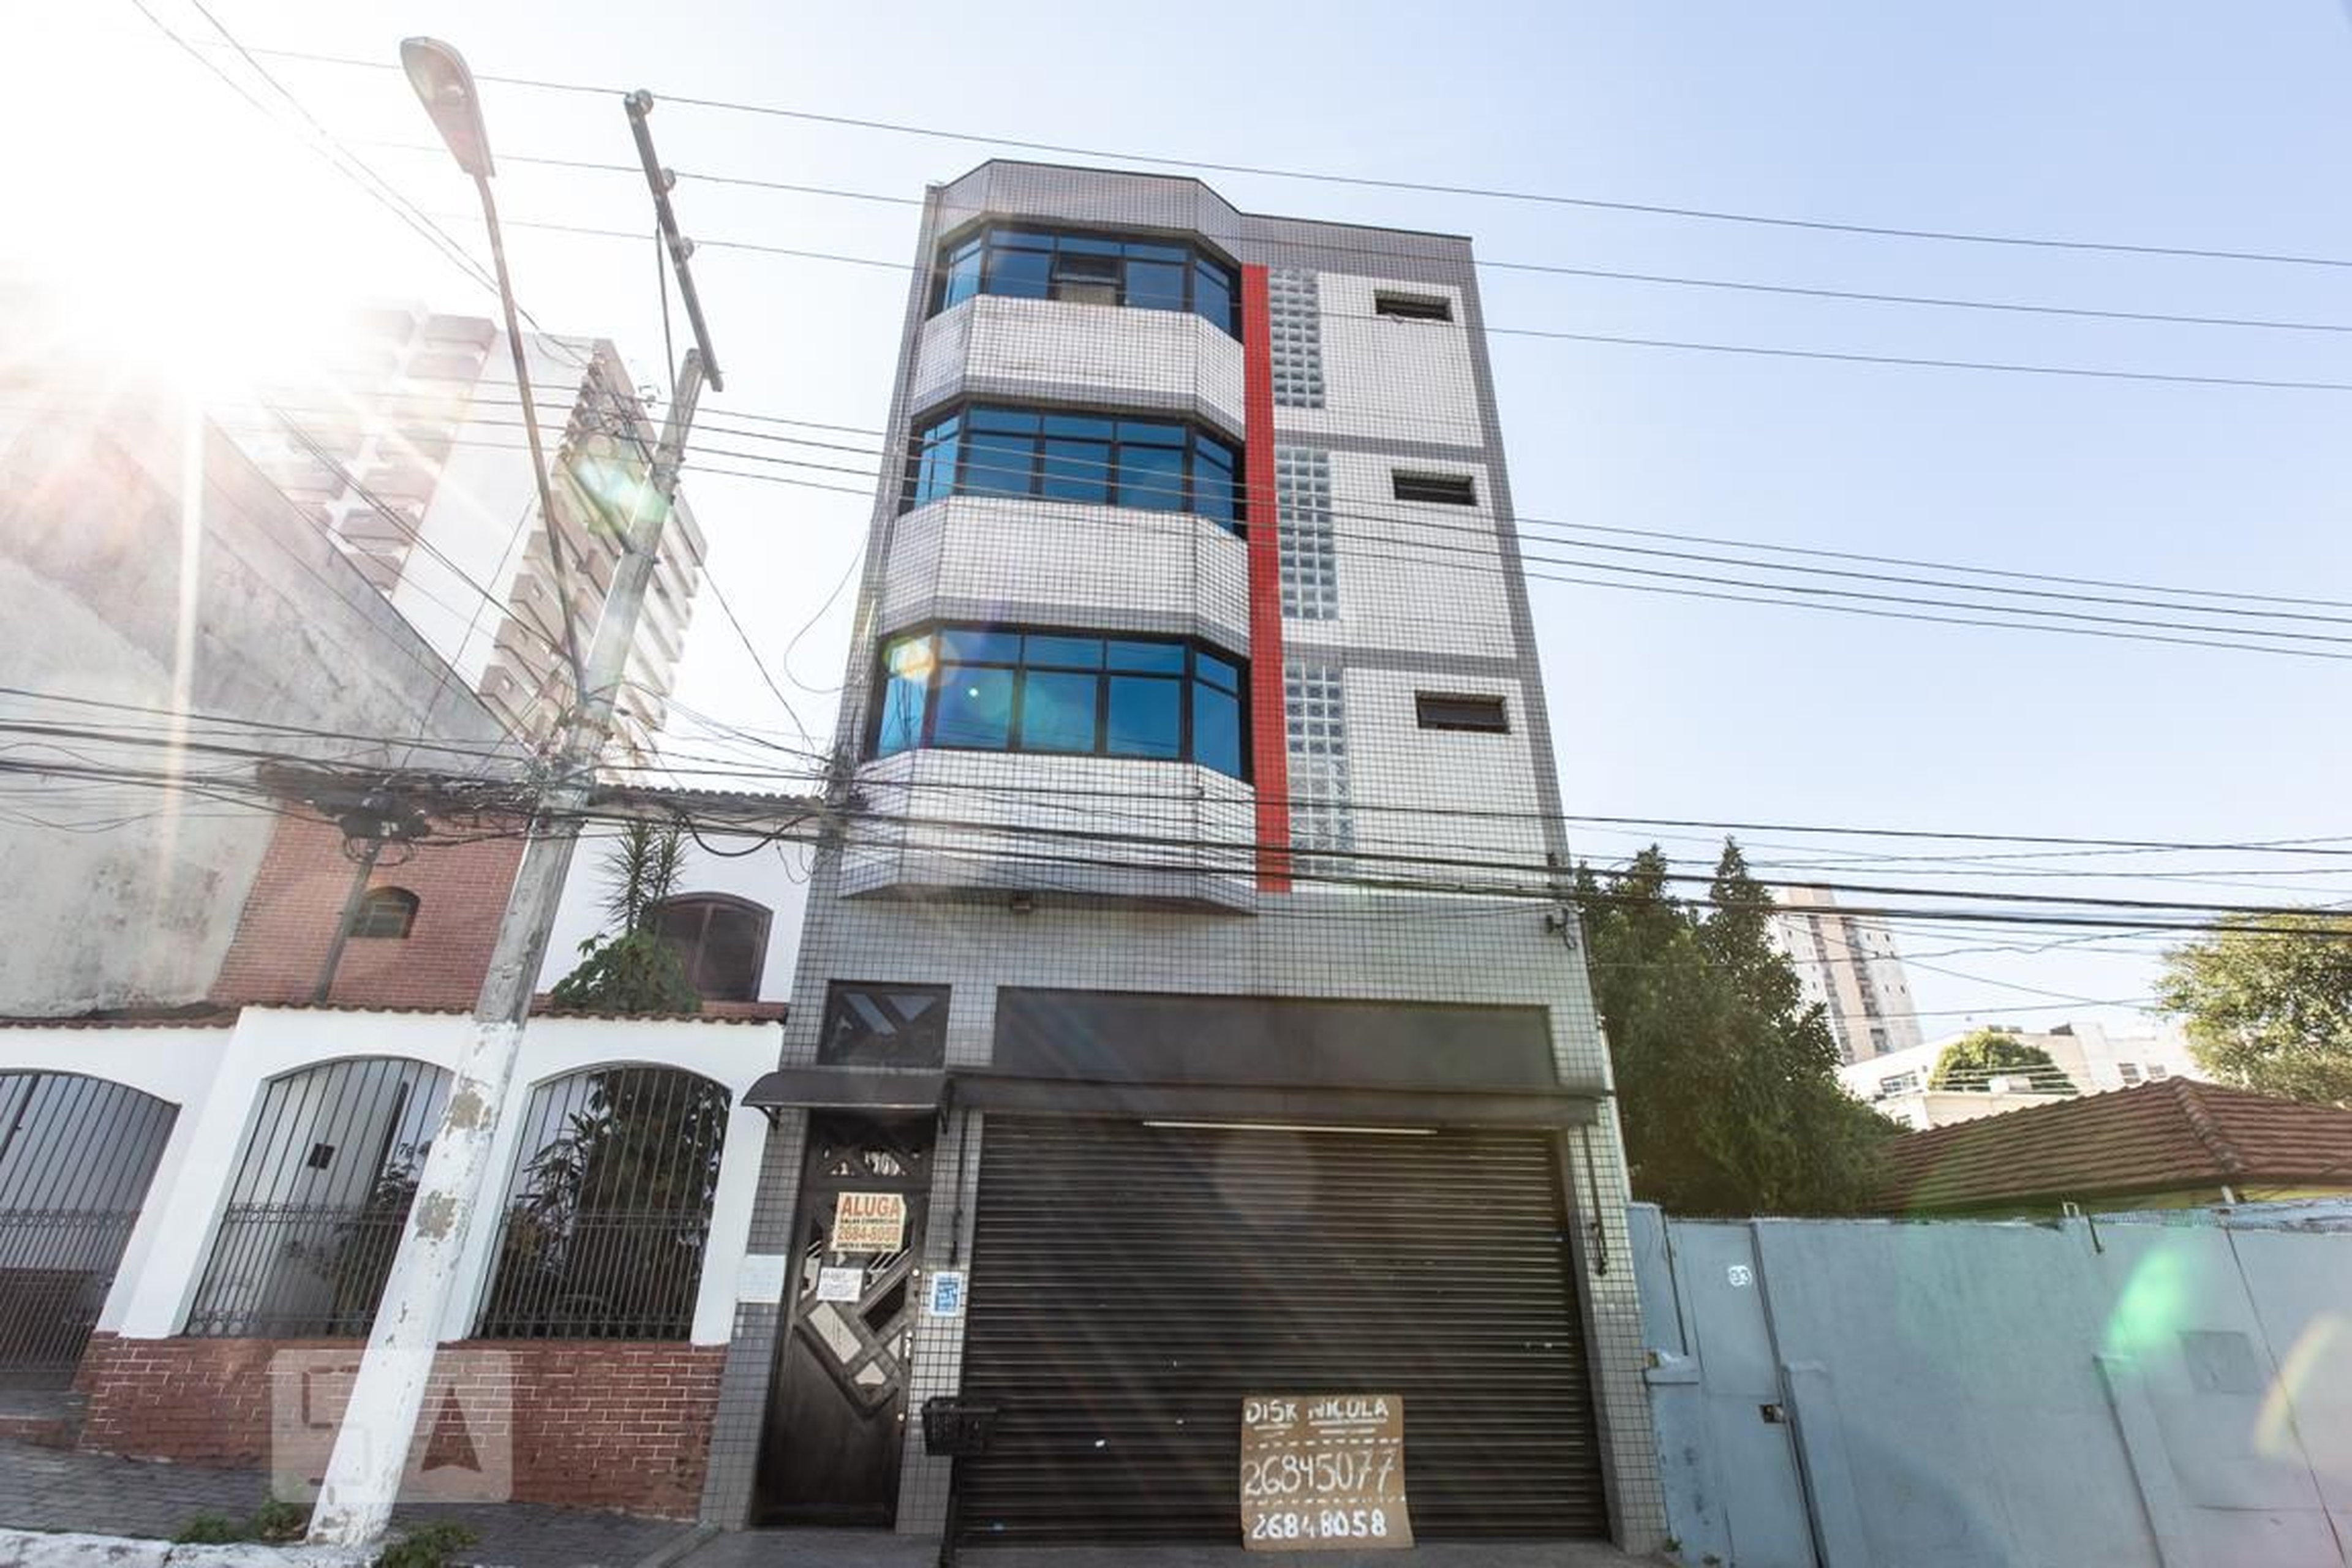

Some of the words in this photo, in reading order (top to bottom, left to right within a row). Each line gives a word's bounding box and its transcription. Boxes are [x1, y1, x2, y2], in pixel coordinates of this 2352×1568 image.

[840, 1195, 900, 1217] ALUGA
[1245, 1400, 1298, 1423] DISK
[1242, 1447, 1398, 1496] 26845077
